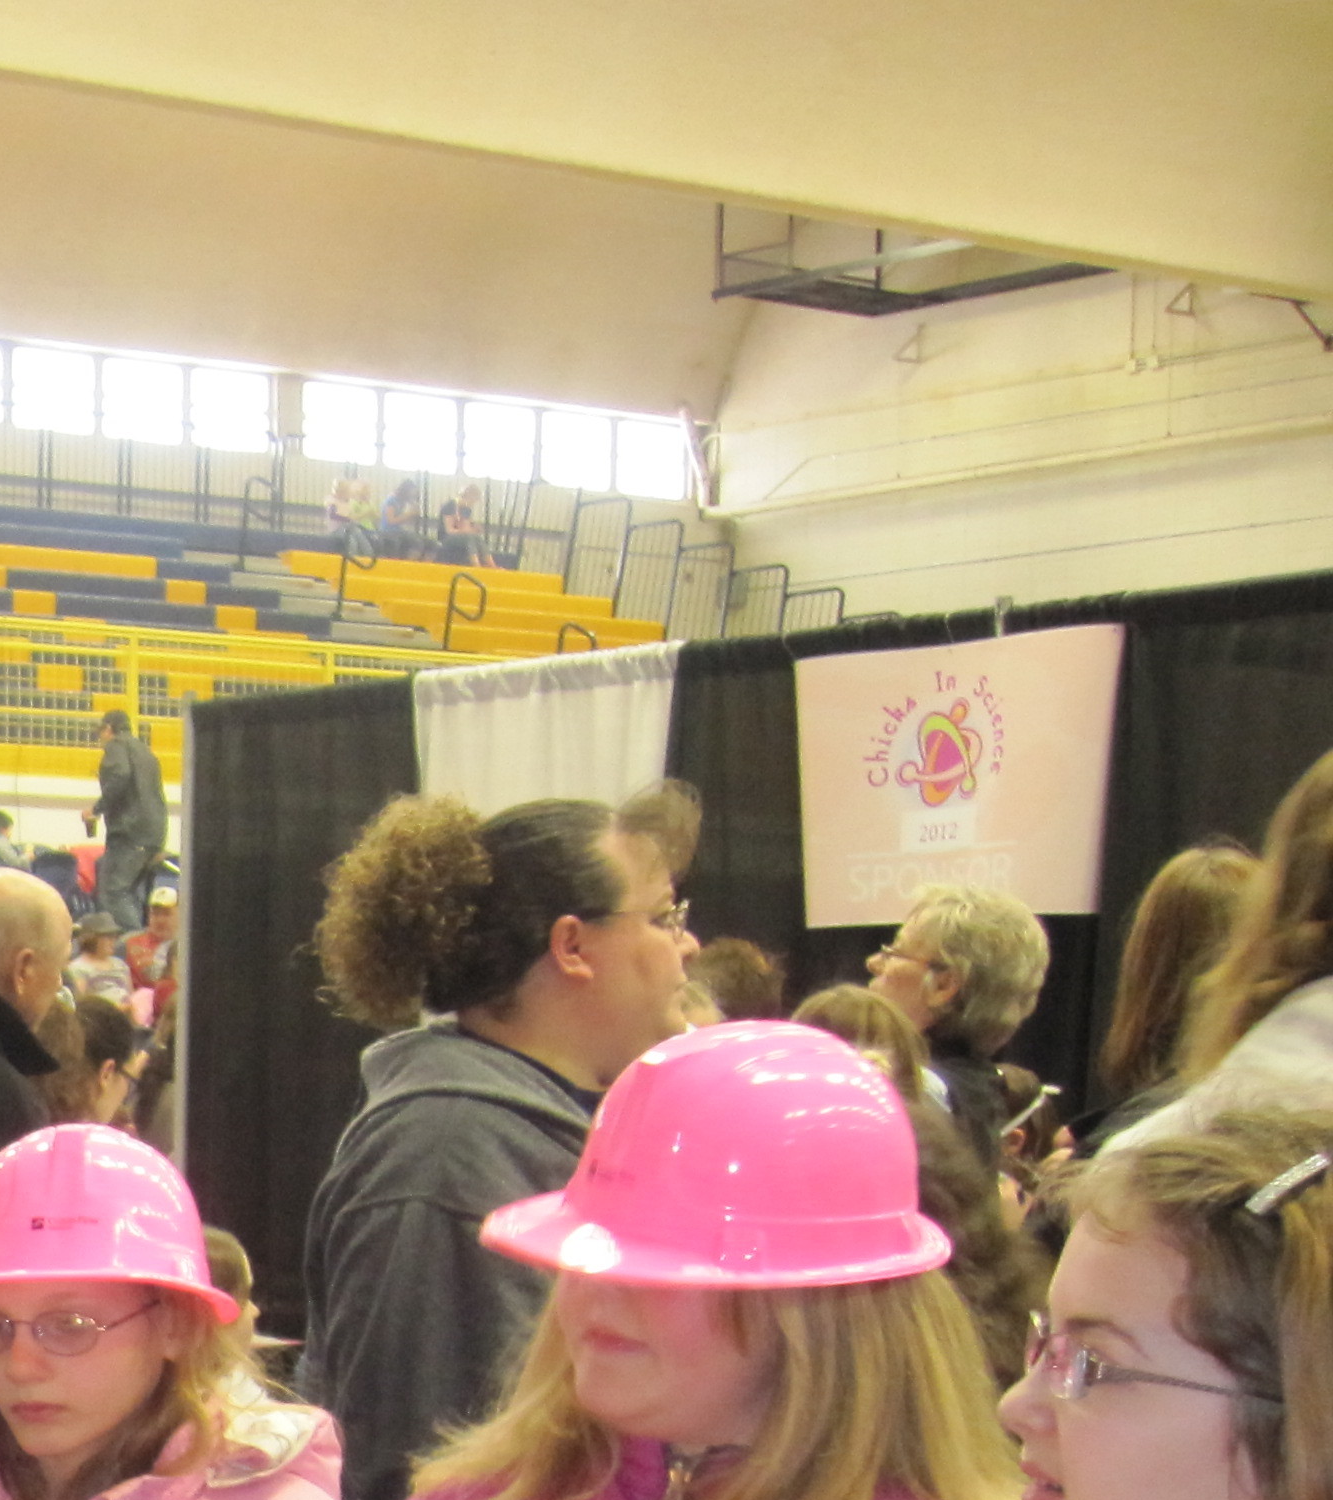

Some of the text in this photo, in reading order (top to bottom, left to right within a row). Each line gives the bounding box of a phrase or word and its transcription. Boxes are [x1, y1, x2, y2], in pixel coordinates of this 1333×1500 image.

[863, 671, 1004, 787] Chicks In Science
[919, 823, 958, 843] 2012
